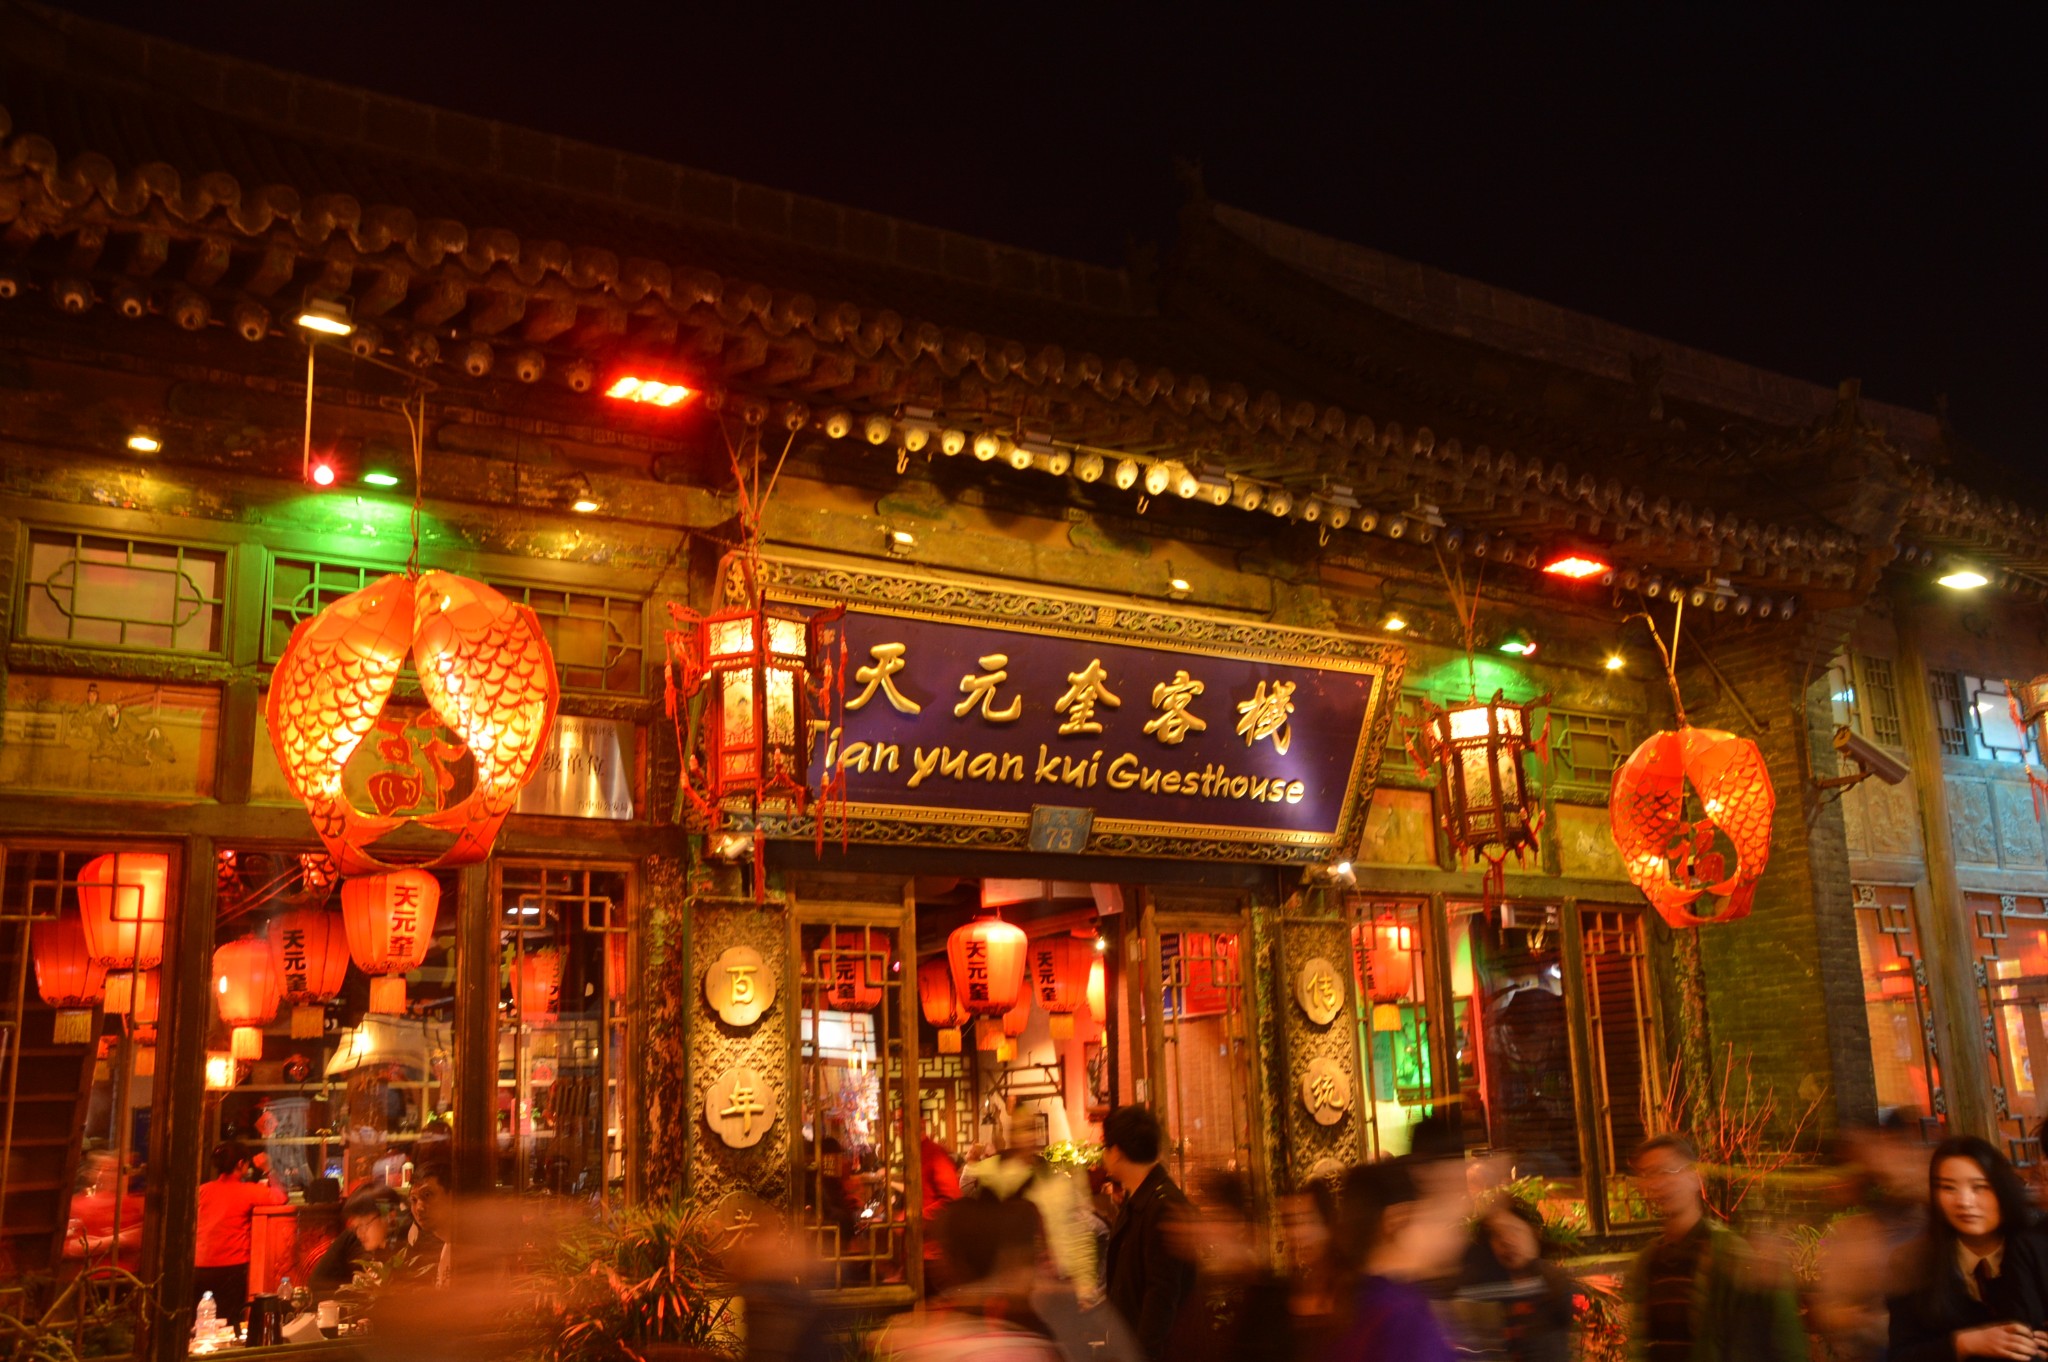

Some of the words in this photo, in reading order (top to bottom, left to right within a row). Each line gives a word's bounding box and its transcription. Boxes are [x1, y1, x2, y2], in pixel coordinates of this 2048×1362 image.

[906, 744, 1024, 788] yuan
[1035, 745, 1102, 788] kui
[1106, 754, 1305, 803] Guesthouse
[387, 885, 419, 957] 天元奎
[282, 929, 308, 994] 天元奎
[966, 940, 990, 1001] 天元奎
[1037, 951, 1057, 1002] 天元奎
